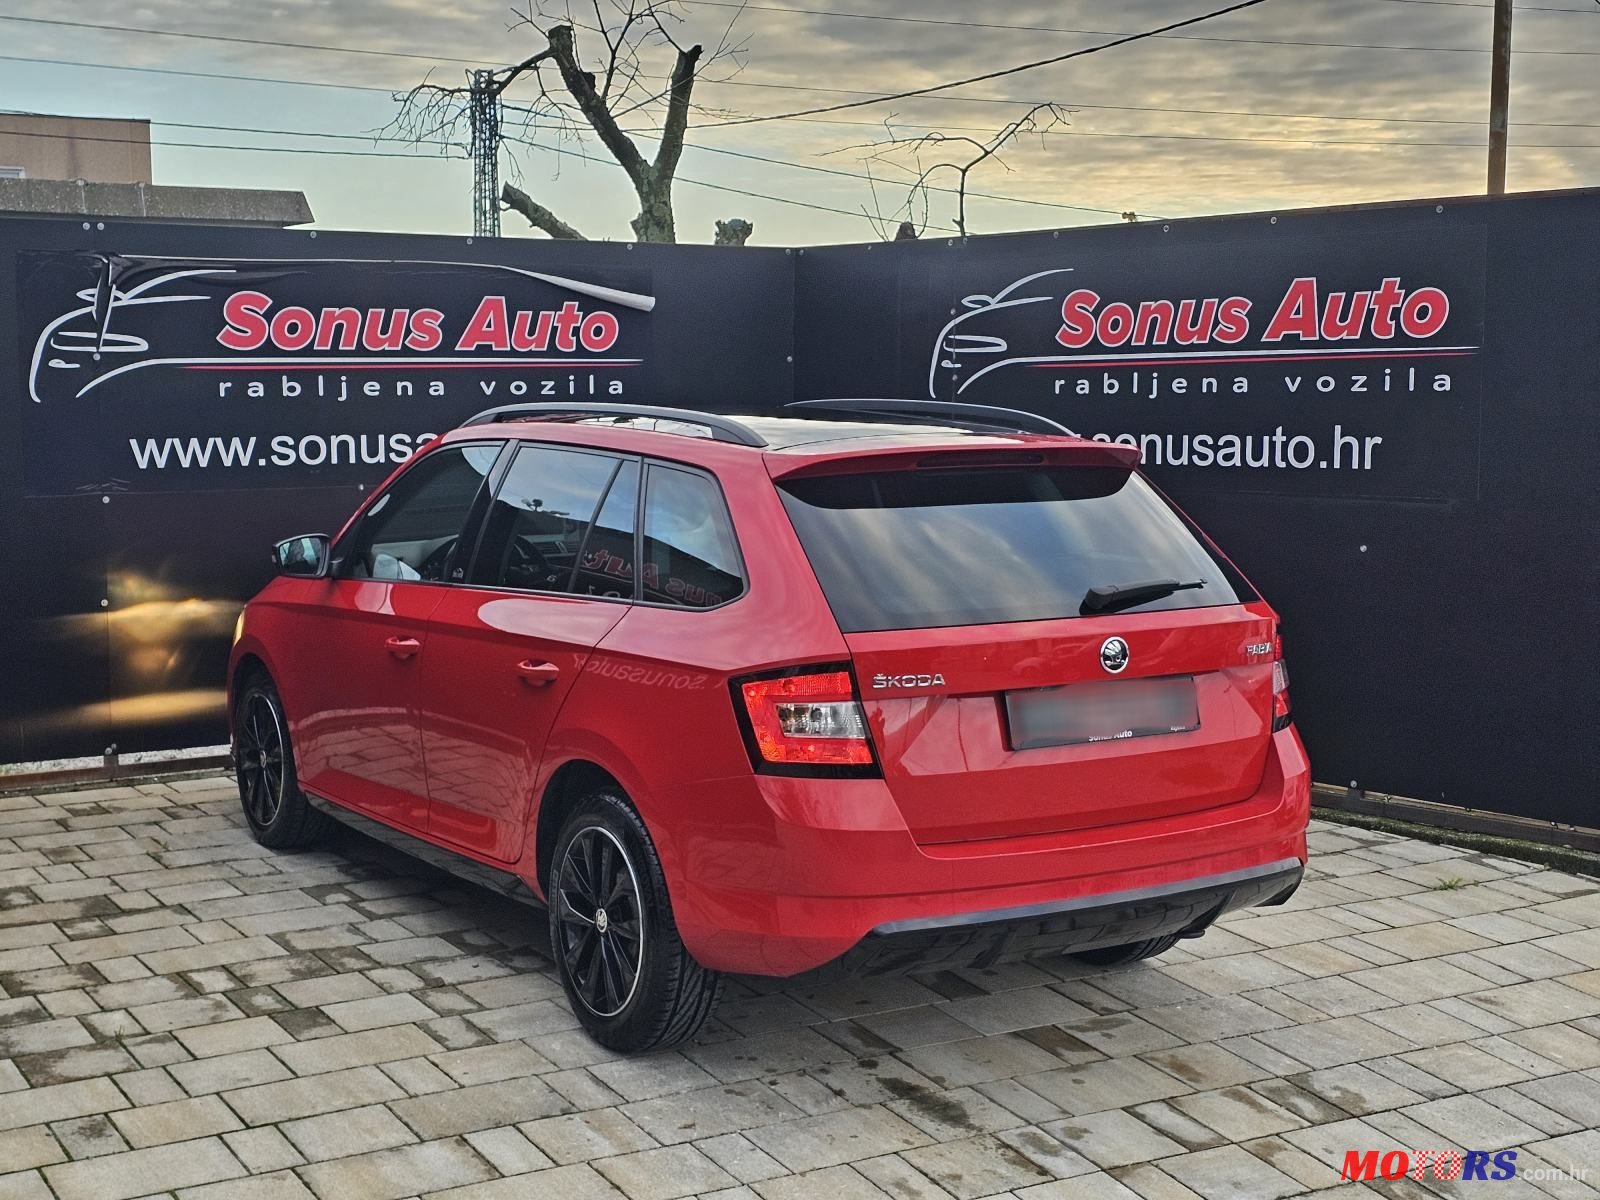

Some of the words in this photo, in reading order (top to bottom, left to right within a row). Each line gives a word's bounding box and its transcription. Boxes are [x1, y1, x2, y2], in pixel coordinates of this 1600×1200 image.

[216, 290, 445, 352] Sonus
[455, 295, 619, 352] Auto
[1055, 288, 1252, 348] Sonus
[1260, 276, 1450, 342] Auto
[218, 375, 445, 402] rabljena
[480, 375, 623, 396] vozila
[1054, 371, 1249, 399] rabljena
[1285, 367, 1451, 392] vozila
[1092, 425, 1383, 470] nusauto.hr
[872, 673, 946, 688] ŠKODA
